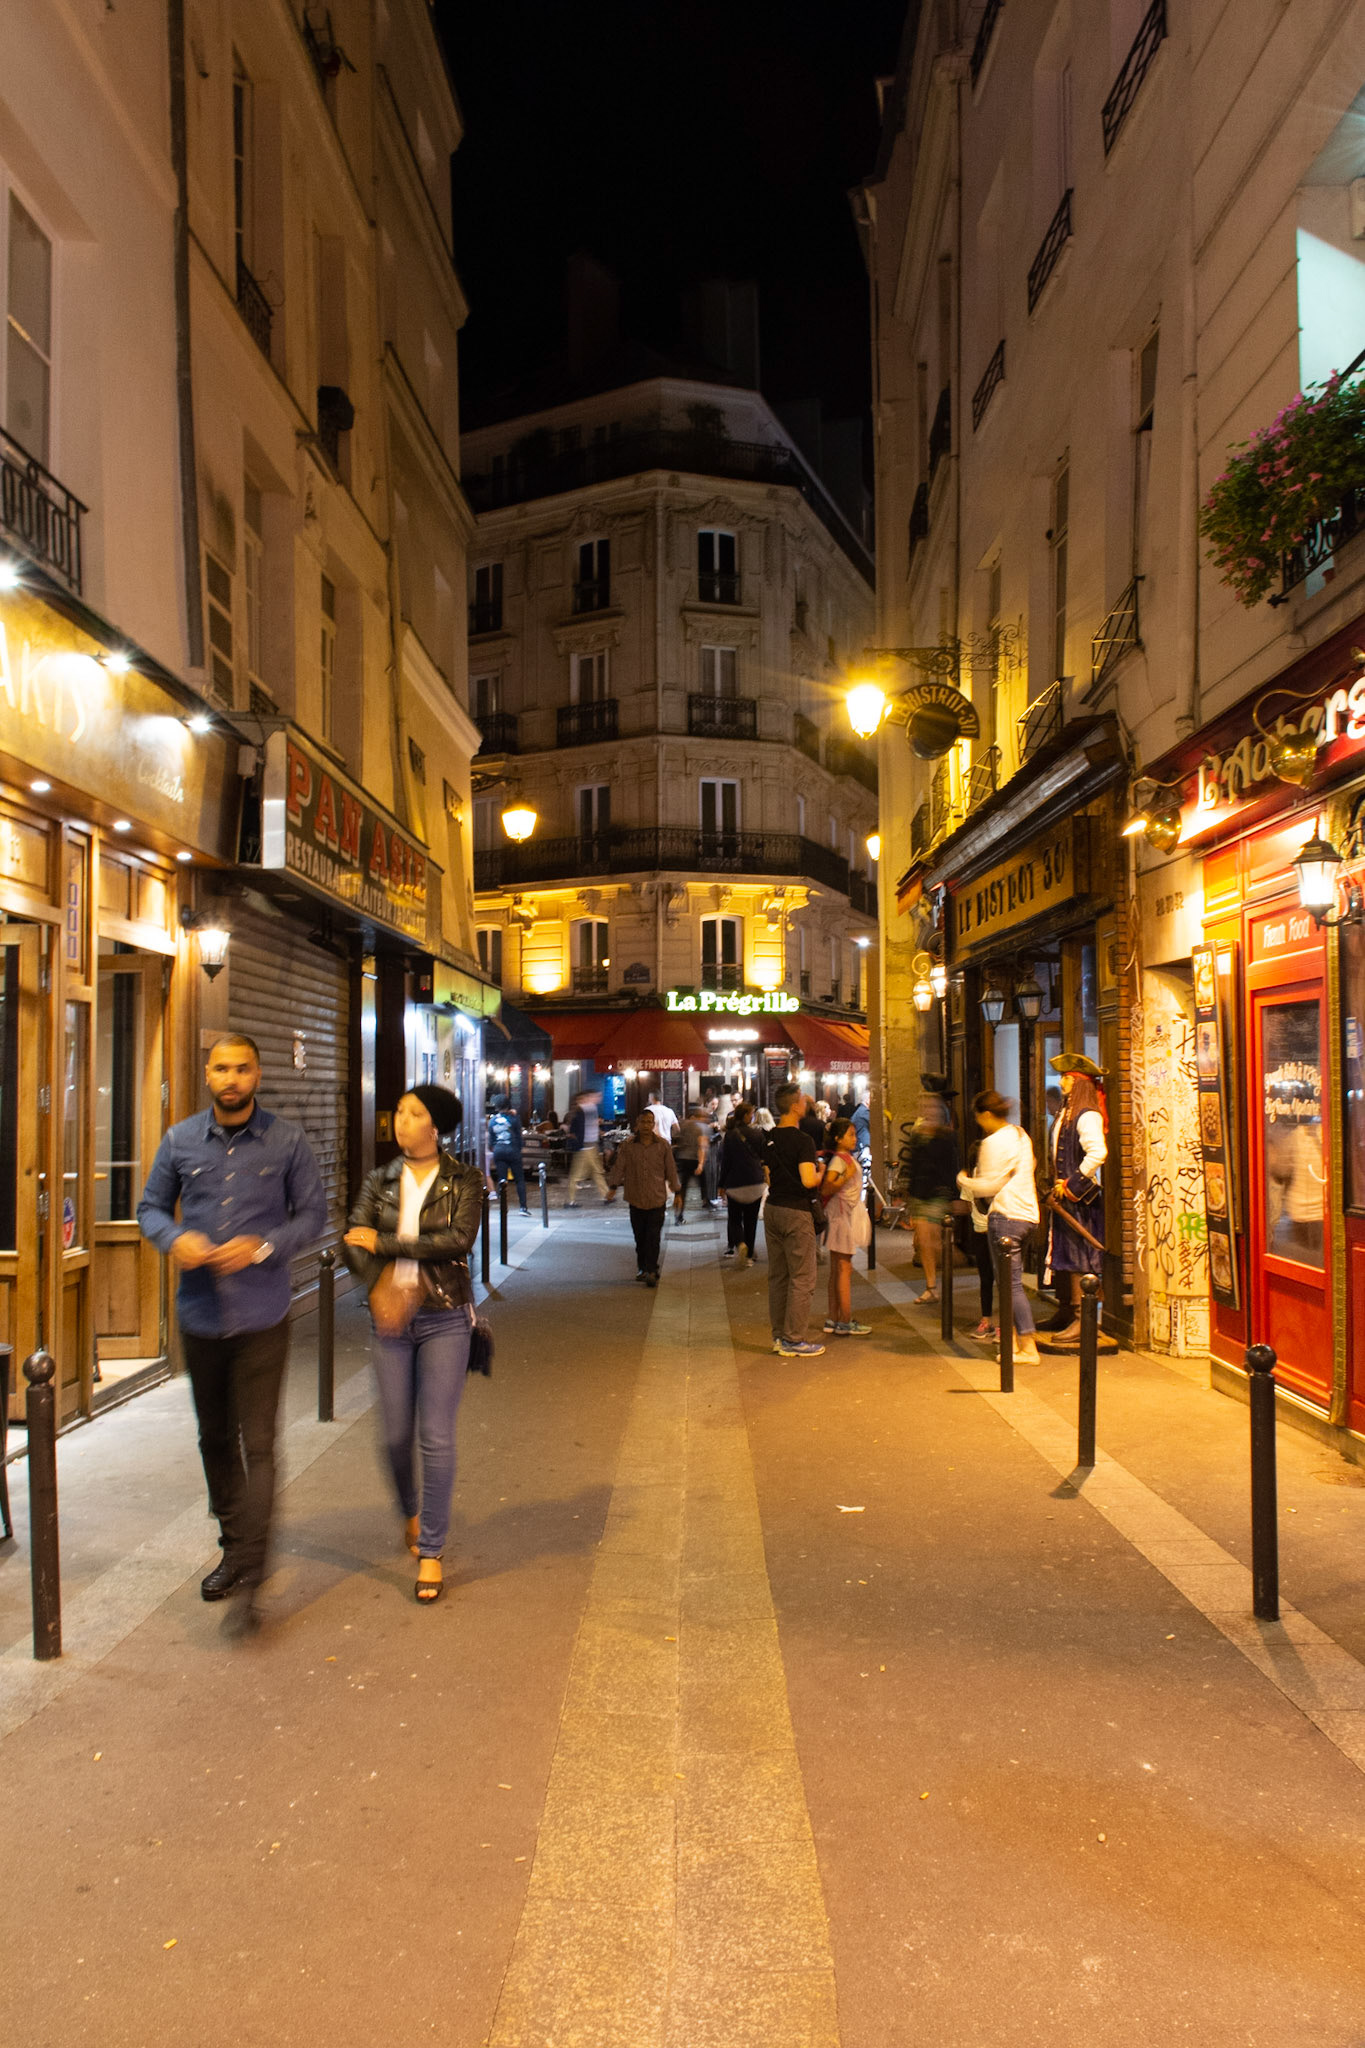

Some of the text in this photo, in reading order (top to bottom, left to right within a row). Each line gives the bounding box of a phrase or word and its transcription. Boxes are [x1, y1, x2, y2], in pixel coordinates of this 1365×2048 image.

[287, 741, 427, 907] PAN ASIE
[959, 898, 972, 936] LE
[976, 860, 1037, 927] BISTROT
[1288, 915, 1312, 942] Food
[667, 990, 801, 1016] La Prégrille
